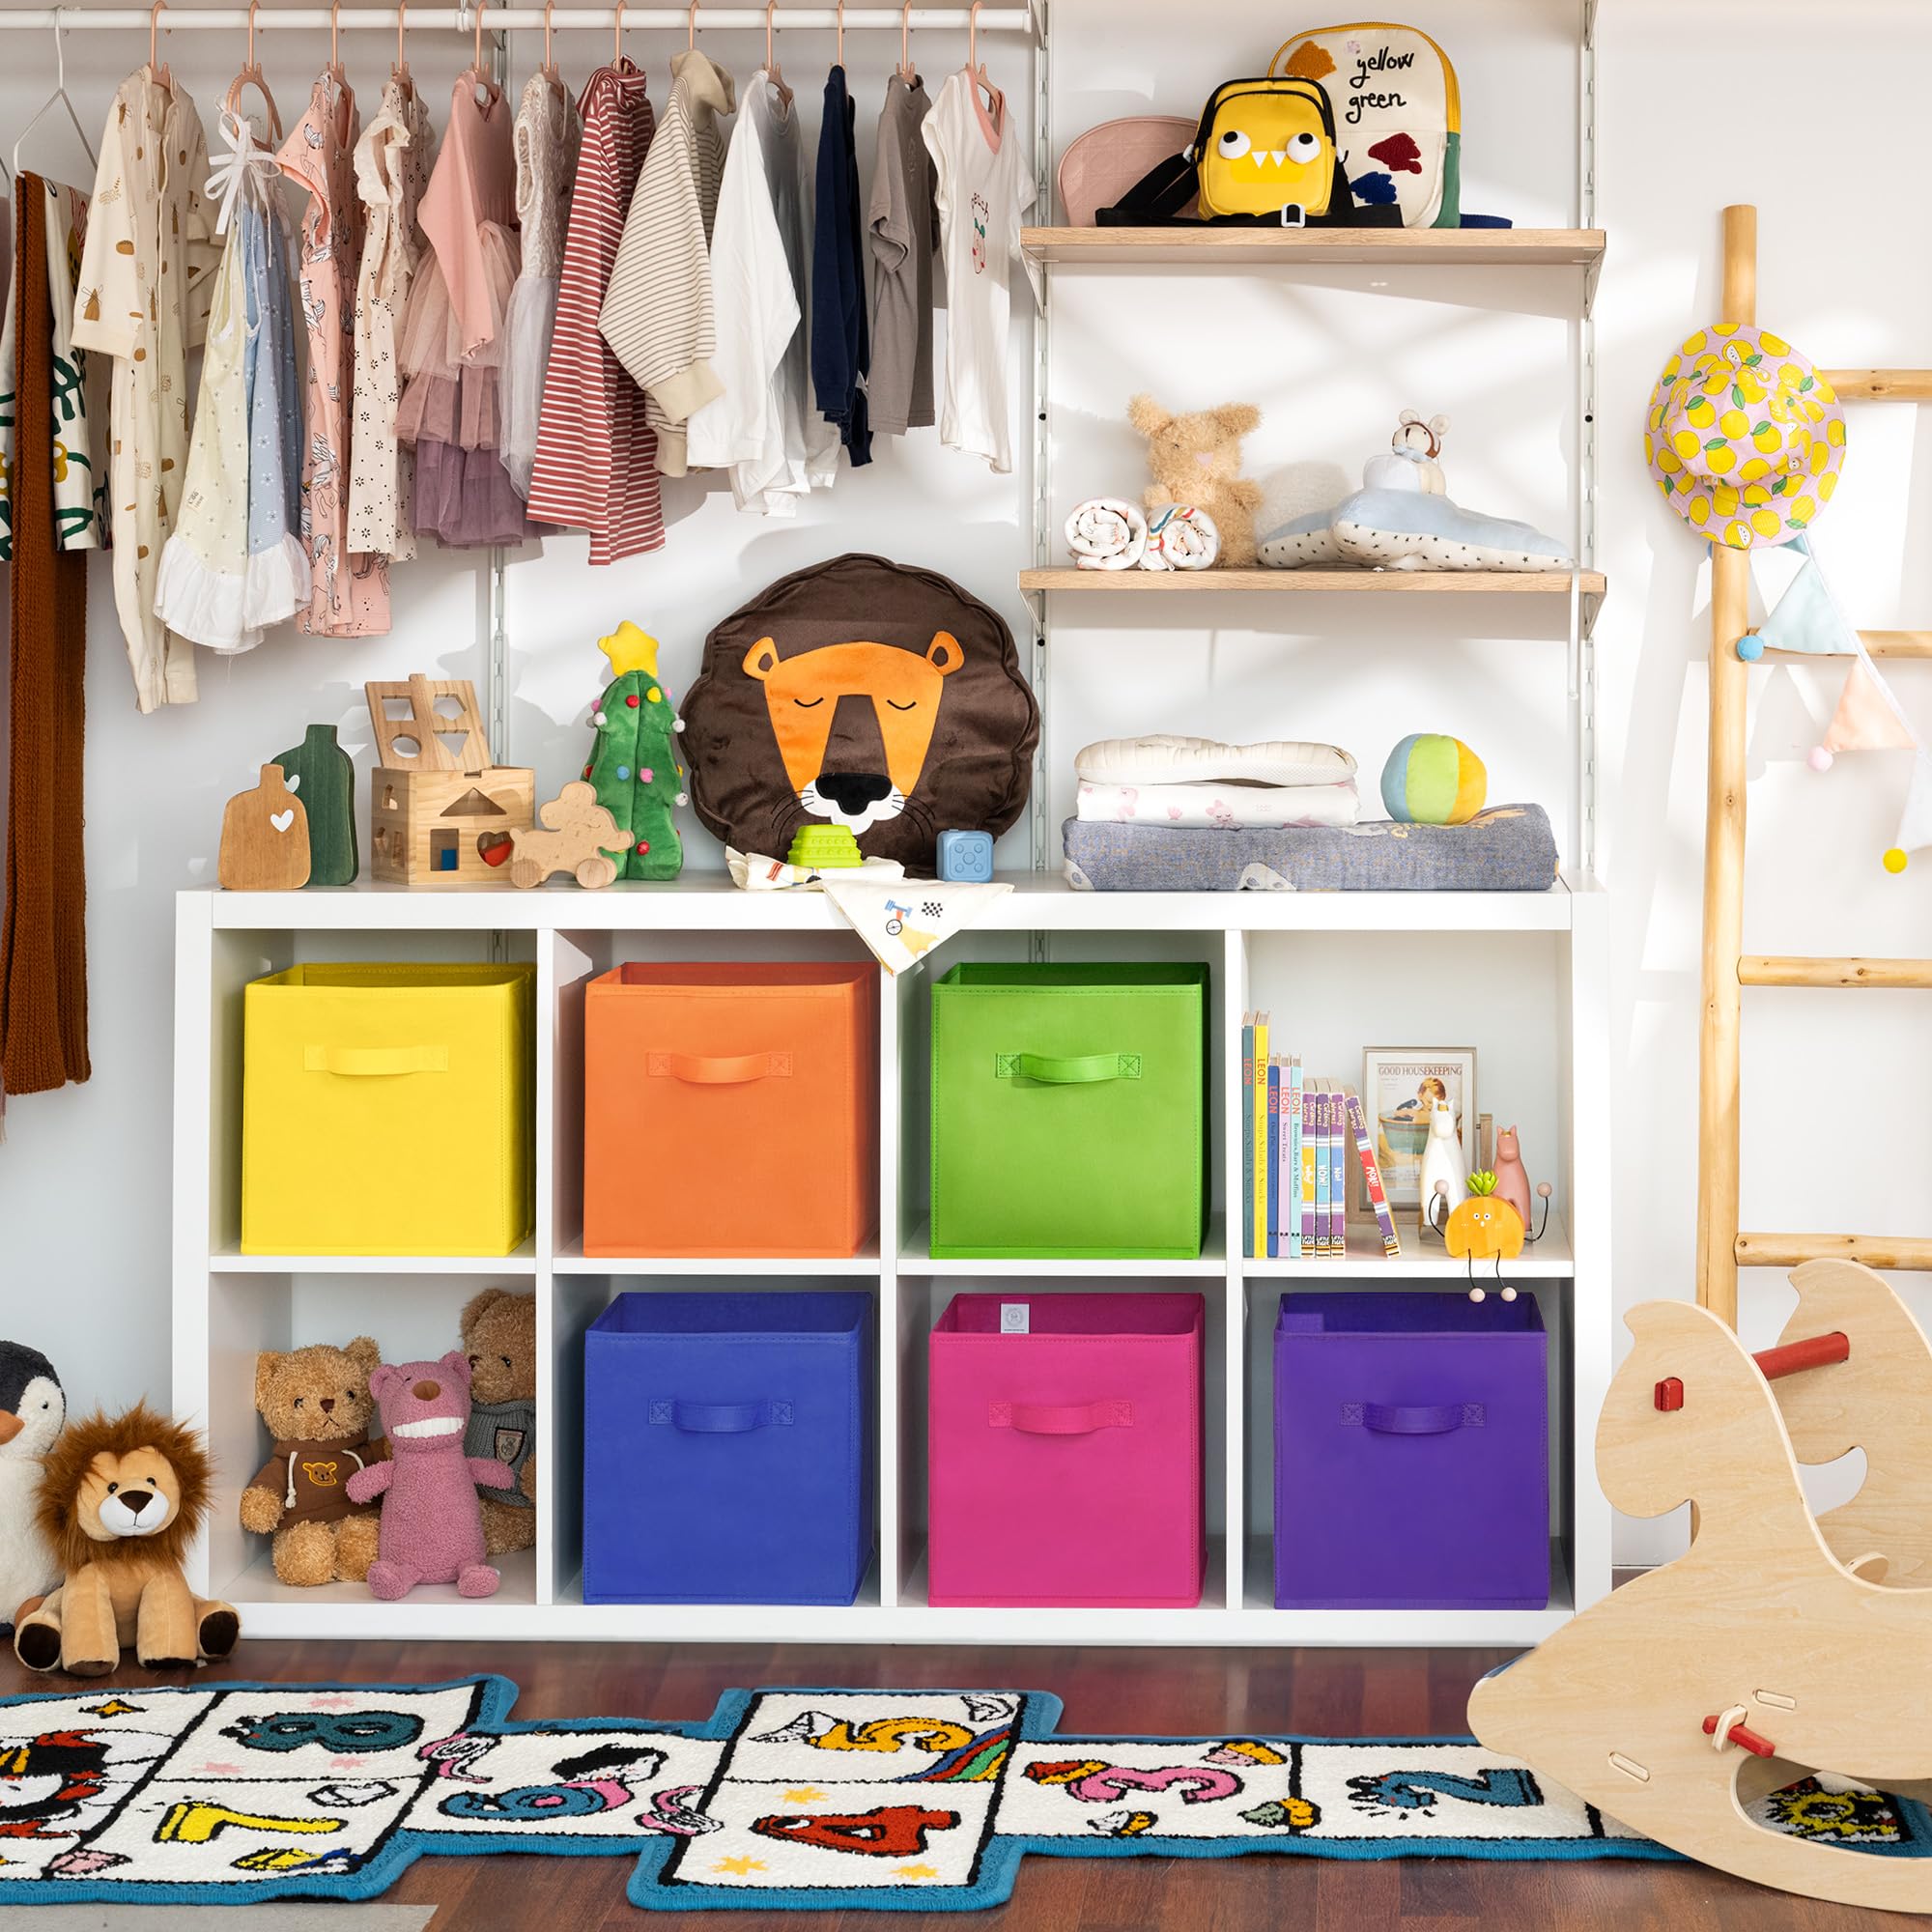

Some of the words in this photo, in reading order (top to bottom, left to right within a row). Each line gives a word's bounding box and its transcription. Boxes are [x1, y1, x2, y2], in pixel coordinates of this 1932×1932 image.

[1349, 46, 1414, 89] yellow
[1345, 92, 1406, 124] green
[1243, 1058, 1253, 1085] LEON
[1257, 1059, 1265, 1085] LEON
[1378, 1065, 1401, 1075] GOOD
[1403, 1065, 1463, 1075] HOUSEKEEPING
[1268, 1086, 1278, 1113] LEON
[1281, 1087, 1290, 1114] LEON
[1292, 1087, 1300, 1114] LEON
[1065, 1765, 1244, 1803] 3
[1366, 1769, 1545, 1809] 2
[152, 1802, 349, 1843] 7
[748, 1804, 961, 1857] 4
